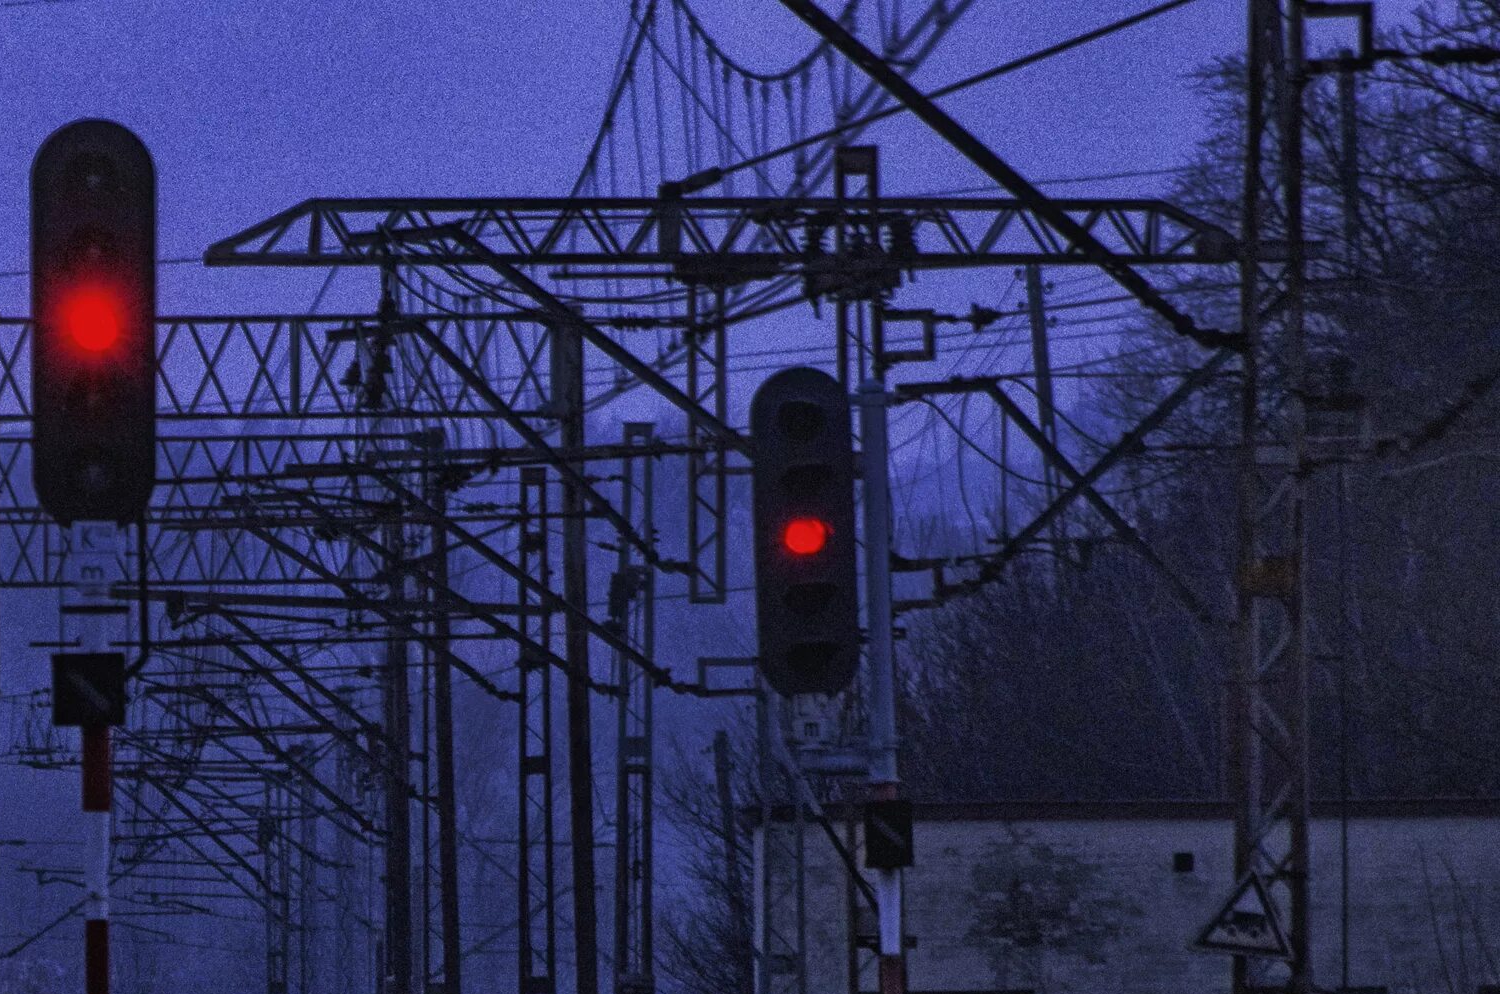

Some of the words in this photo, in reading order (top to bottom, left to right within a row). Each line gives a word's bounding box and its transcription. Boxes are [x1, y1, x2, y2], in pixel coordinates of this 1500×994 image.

[81, 525, 95, 548] K
[81, 565, 105, 580] m
[803, 721, 820, 738] m
